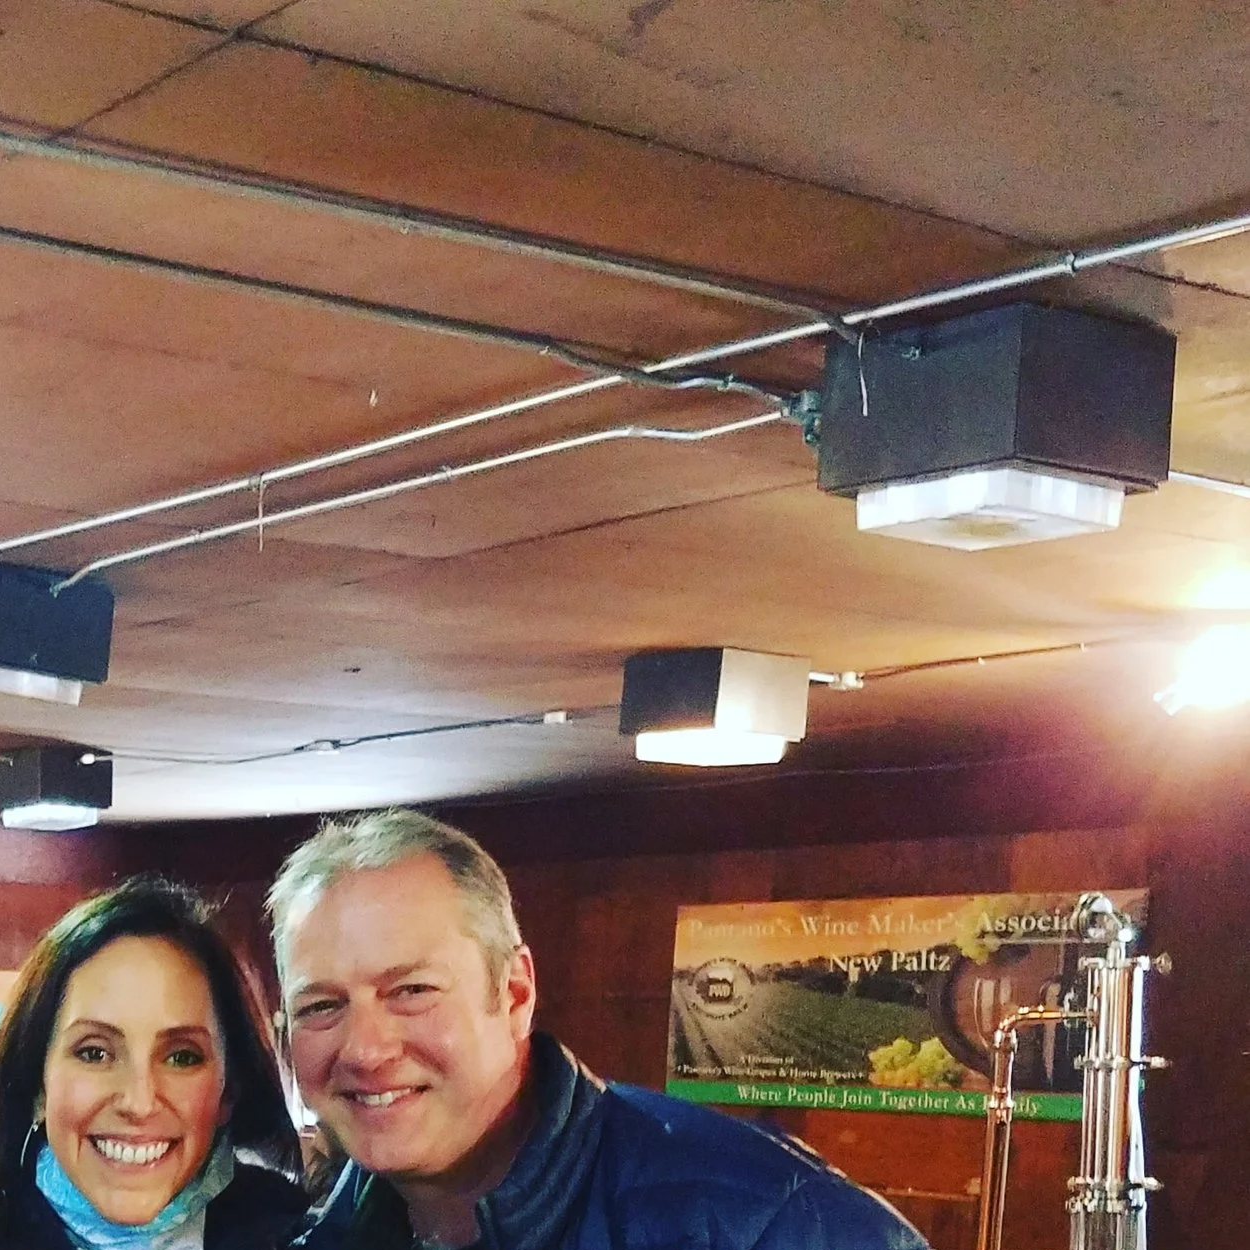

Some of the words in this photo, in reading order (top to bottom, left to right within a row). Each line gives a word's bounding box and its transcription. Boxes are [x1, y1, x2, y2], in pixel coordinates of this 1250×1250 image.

[801, 914, 859, 938] Wine
[867, 911, 964, 935] Maker's
[830, 952, 883, 973] New
[891, 948, 951, 973] Paltz
[778, 1067, 788, 1079] &
[737, 1084, 782, 1102] Where
[788, 1086, 836, 1108] People
[838, 1088, 872, 1110] Join
[879, 1090, 950, 1111] Together
[955, 1094, 976, 1111] As
